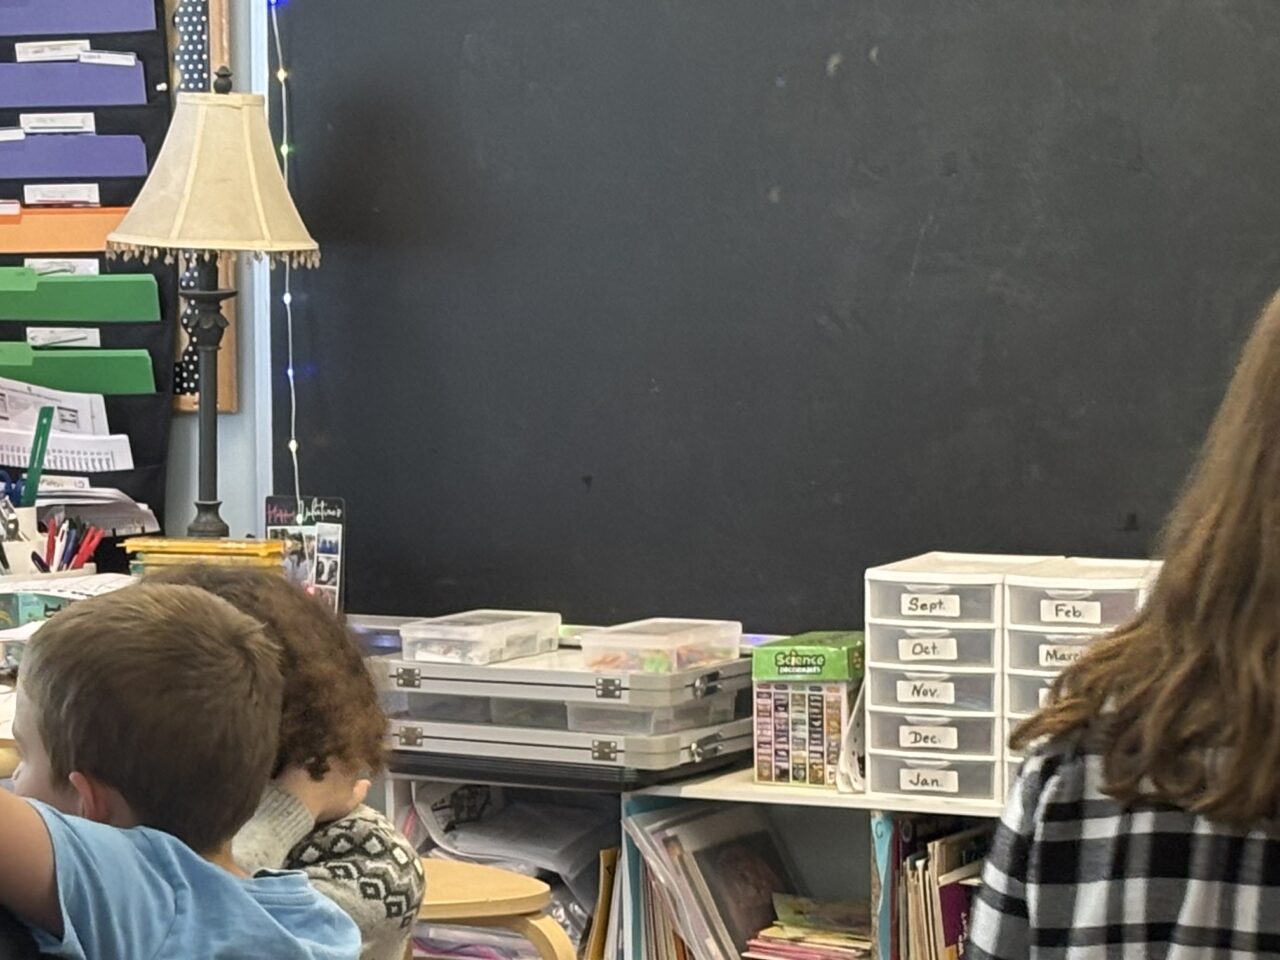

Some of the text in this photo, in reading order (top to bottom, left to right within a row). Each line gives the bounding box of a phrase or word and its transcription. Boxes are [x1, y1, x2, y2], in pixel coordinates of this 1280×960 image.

[907, 596, 946, 613] Sept.
[776, 651, 825, 666] Science
[1045, 649, 1081, 662] Marc
[911, 683, 940, 698] Nov.
[908, 731, 942, 744] Dec.
[909, 772, 944, 787] Jan.
